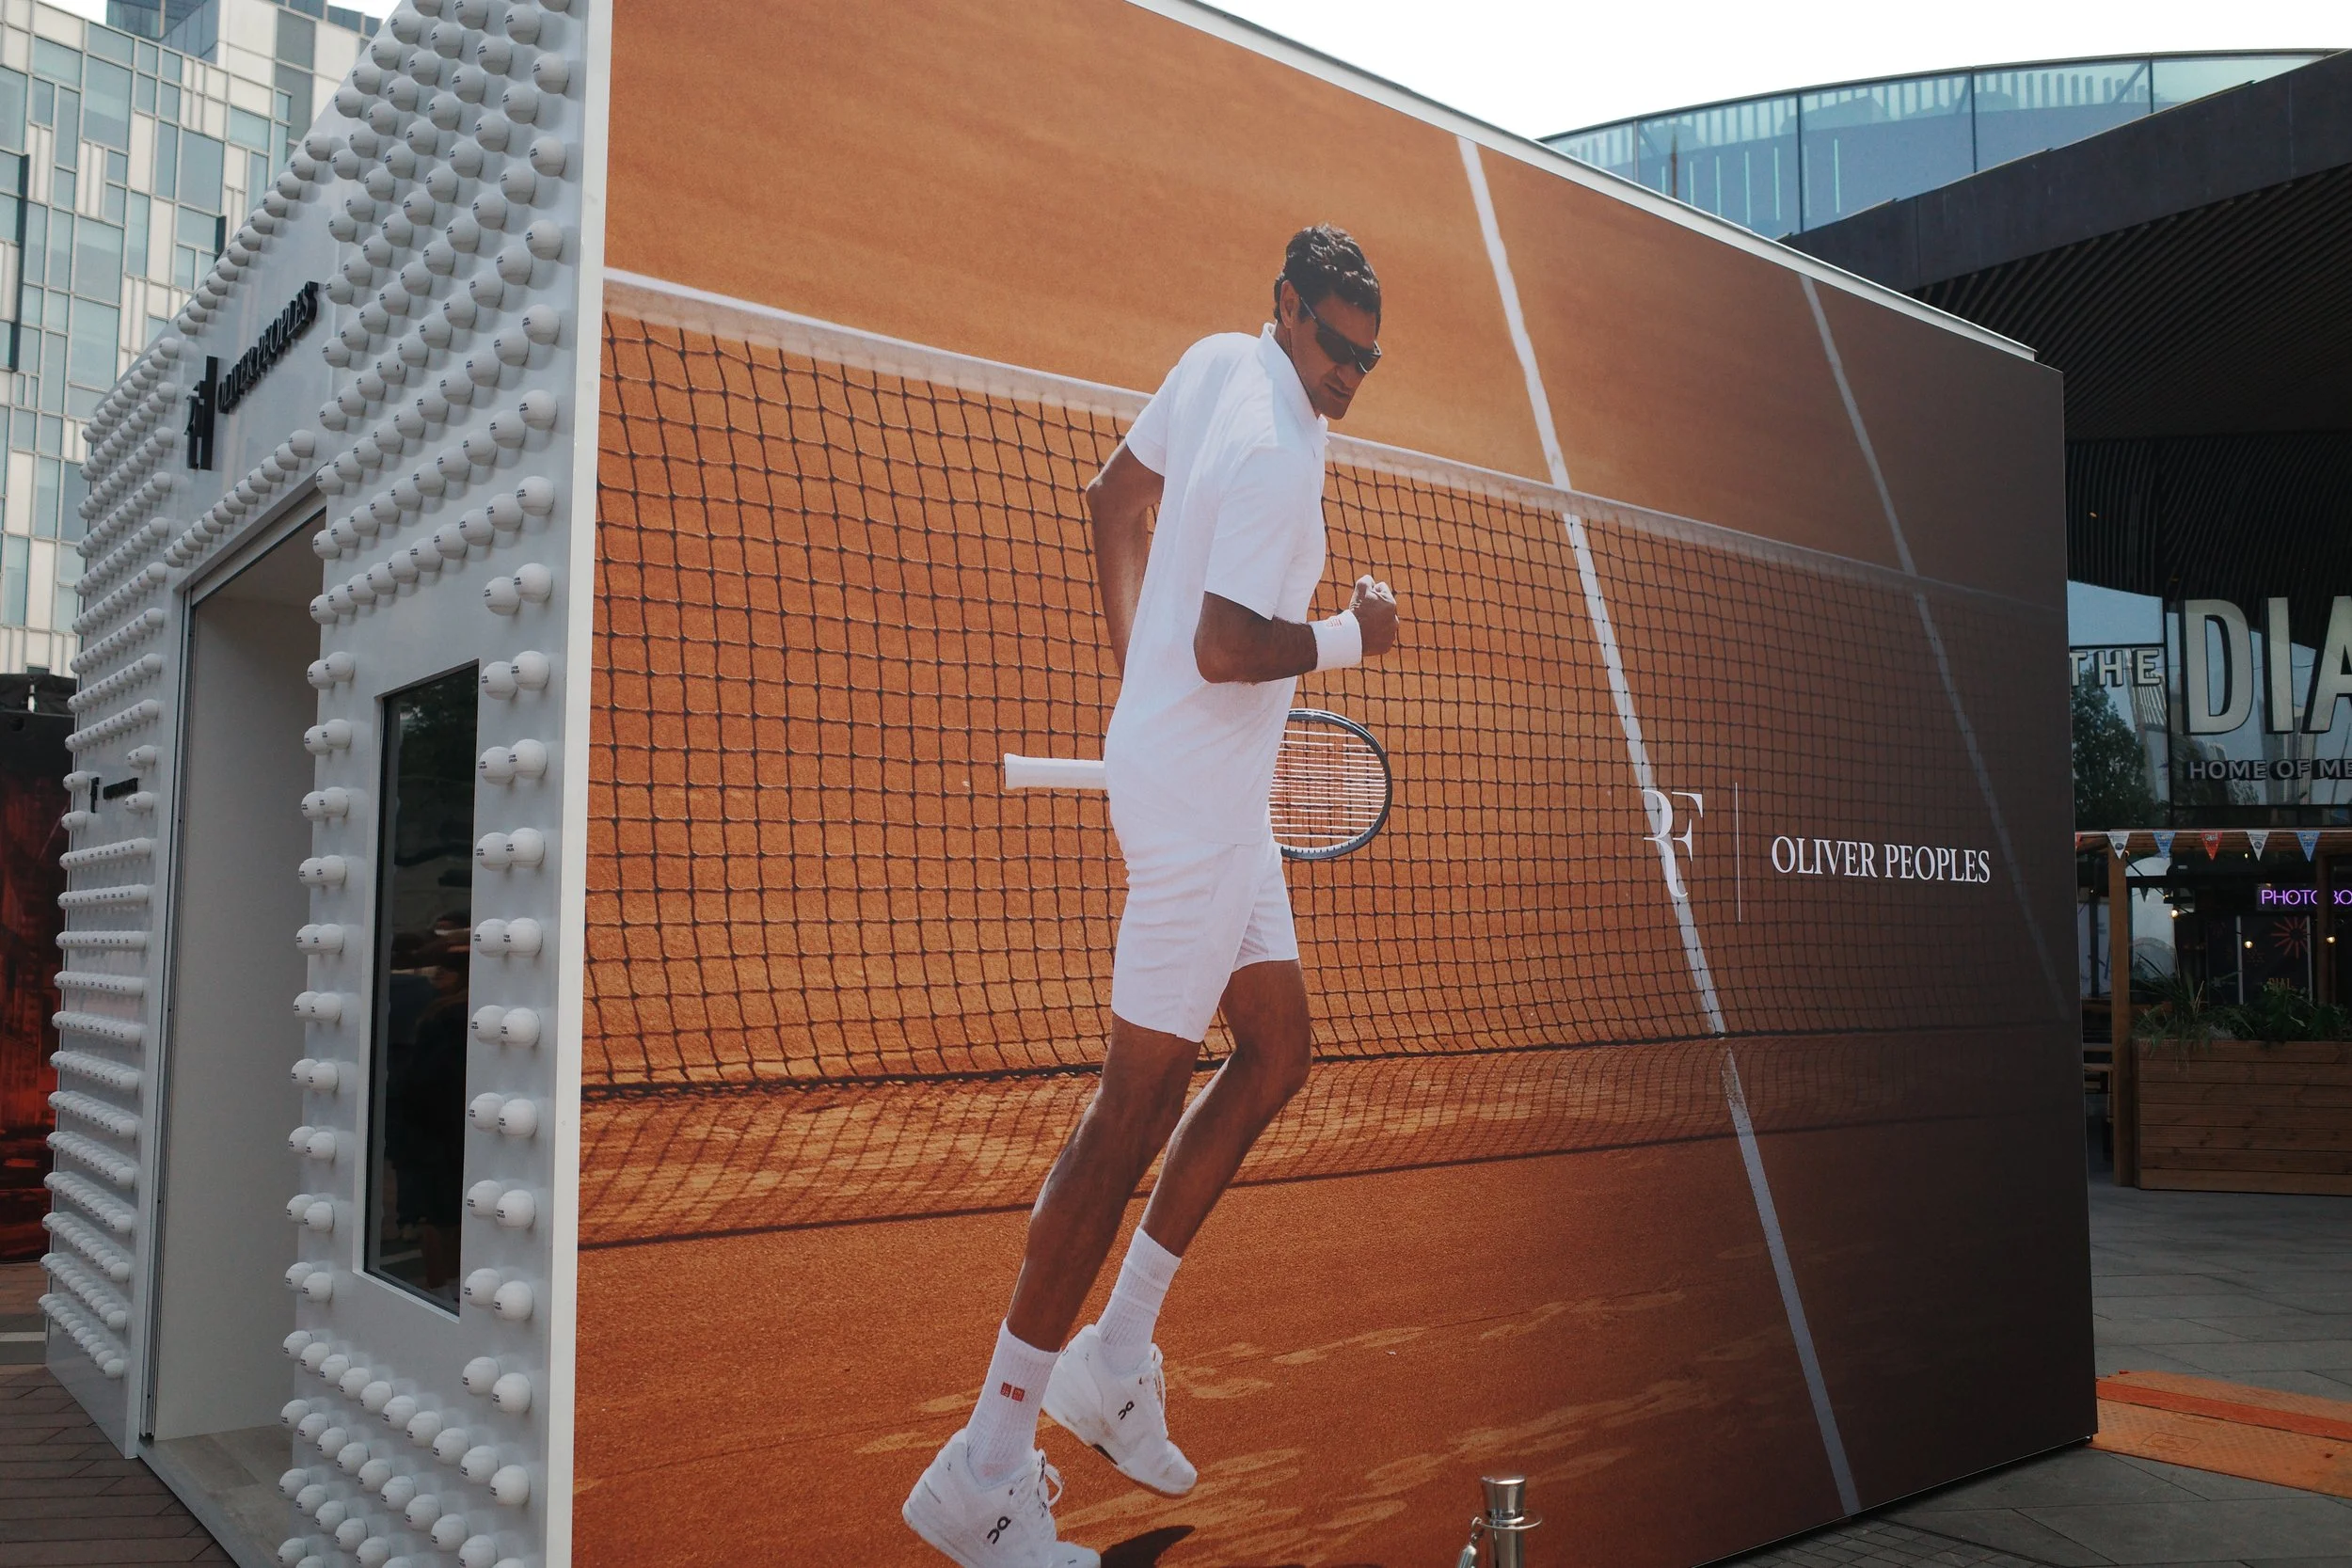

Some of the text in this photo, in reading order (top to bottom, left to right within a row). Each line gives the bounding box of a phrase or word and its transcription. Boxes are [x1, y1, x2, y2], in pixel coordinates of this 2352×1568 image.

[217, 280, 319, 414] OLIVER PEOPLES
[2069, 647, 2161, 687] THE
[2181, 595, 2352, 735] DIA
[2187, 759, 2267, 781] HOME
[2270, 758, 2312, 781] OF
[1771, 835, 1991, 884] OLIVER PEOPLES
